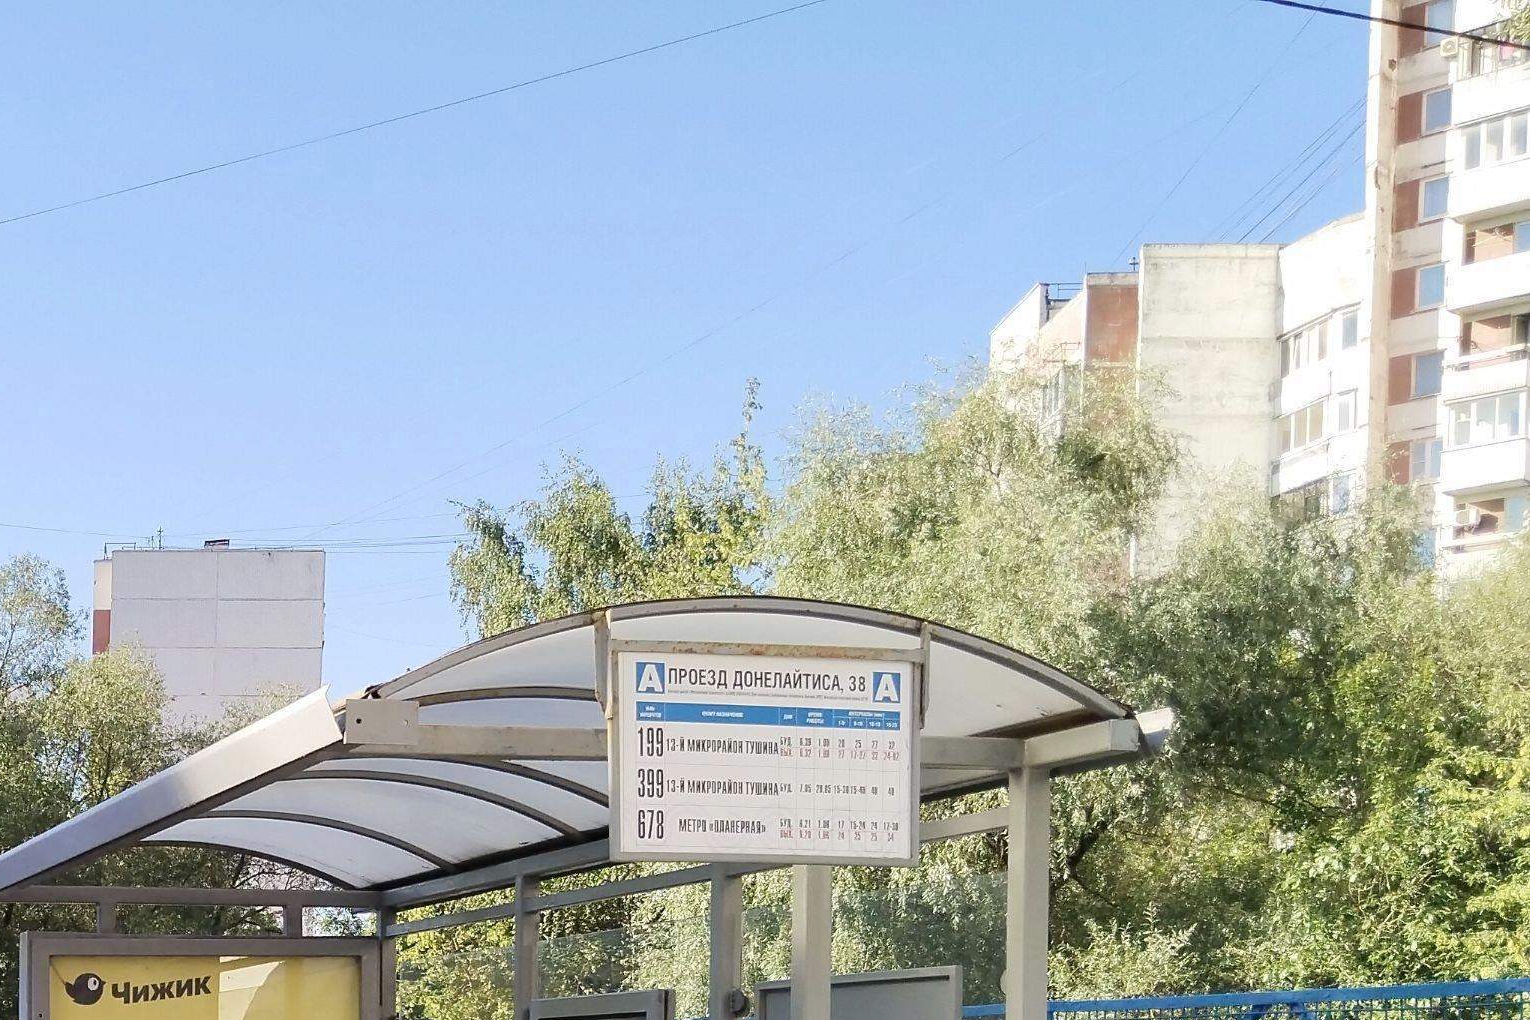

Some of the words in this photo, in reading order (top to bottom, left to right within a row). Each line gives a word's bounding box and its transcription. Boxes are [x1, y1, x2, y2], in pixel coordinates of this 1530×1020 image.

[668, 667, 728, 690] ПРОЕЗД
[733, 668, 844, 694] ДОНЕЛАЙТИСА,
[849, 675, 866, 693] 38
[638, 726, 664, 757] 199
[687, 737, 743, 754] МИКРОРАЙОН
[745, 740, 779, 755] ТУШИНА
[638, 768, 664, 798] 399
[666, 777, 685, 793] 13-Й
[687, 778, 743, 795] МИКРОРАЙОН
[745, 781, 779, 796] ТУШИНА
[638, 809, 664, 839] 678
[678, 818, 707, 833] МЕТРО
